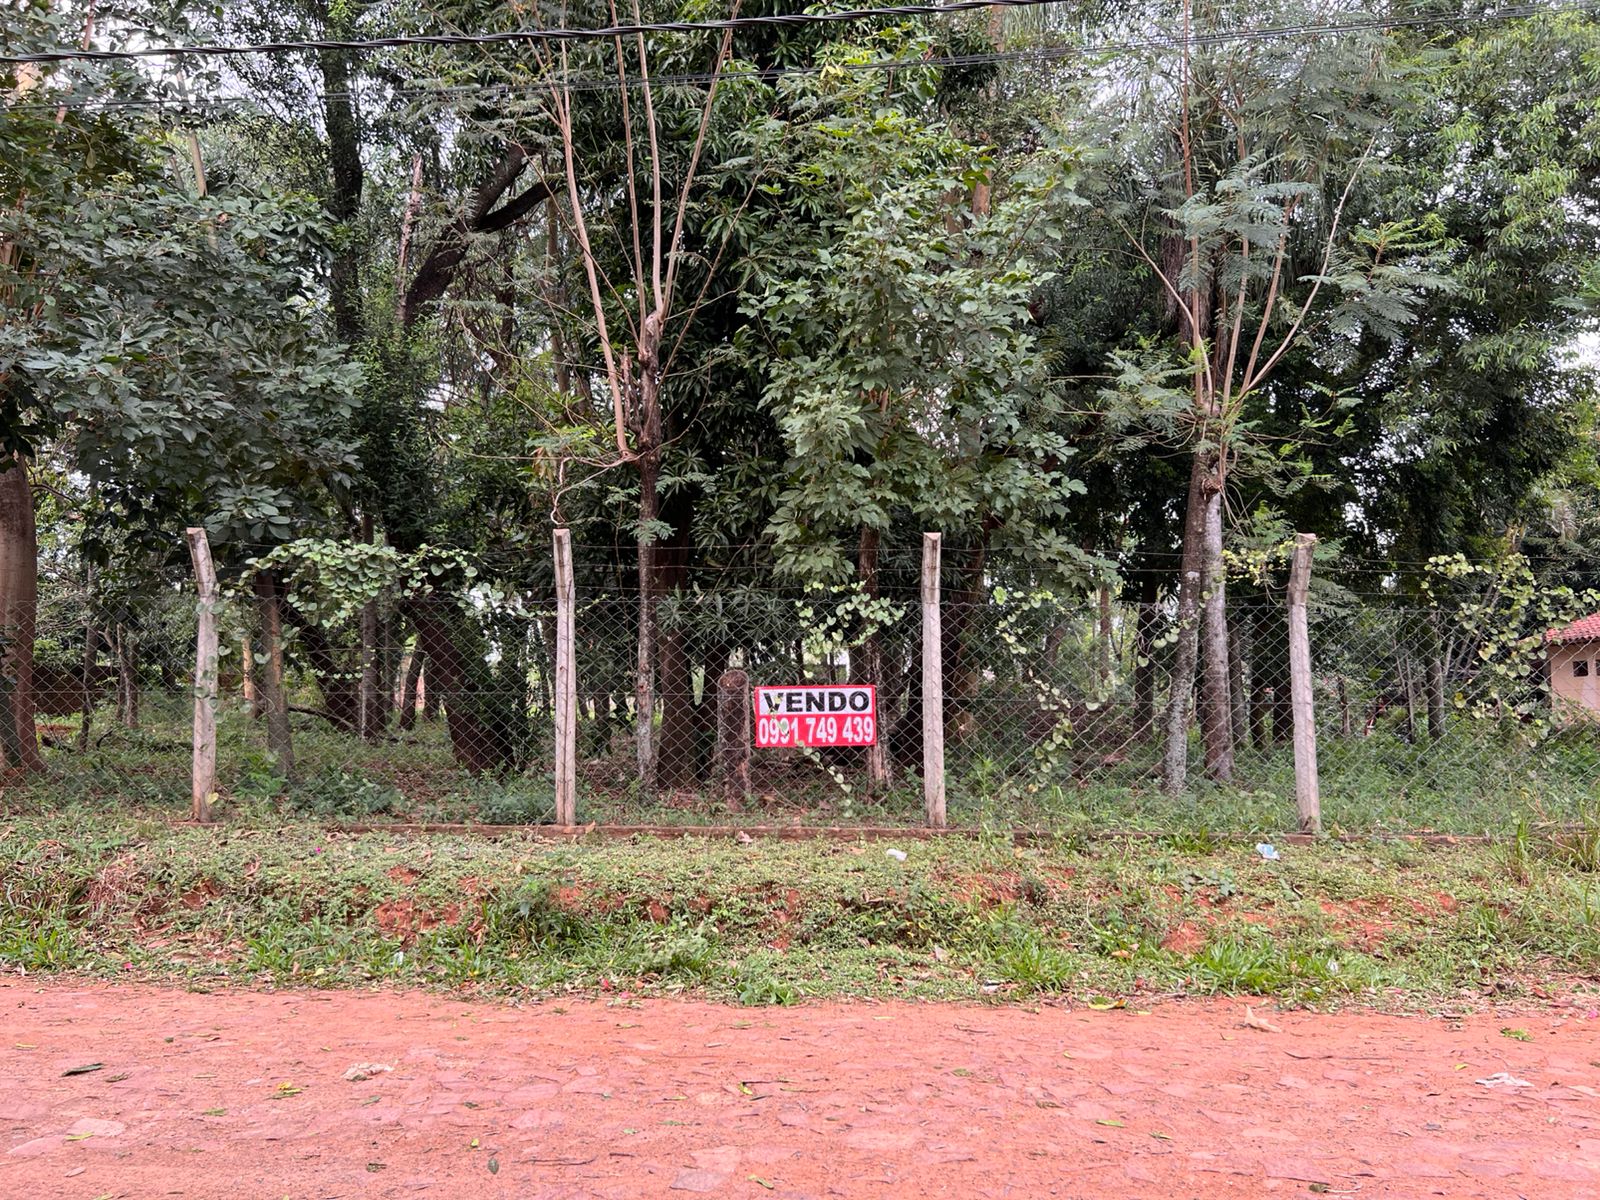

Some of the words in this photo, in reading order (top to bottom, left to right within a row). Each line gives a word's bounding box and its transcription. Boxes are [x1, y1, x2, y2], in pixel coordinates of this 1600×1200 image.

[763, 690, 869, 712] VENDO
[758, 717, 799, 744] 0991
[805, 716, 837, 743] 749
[842, 716, 873, 743] 439
